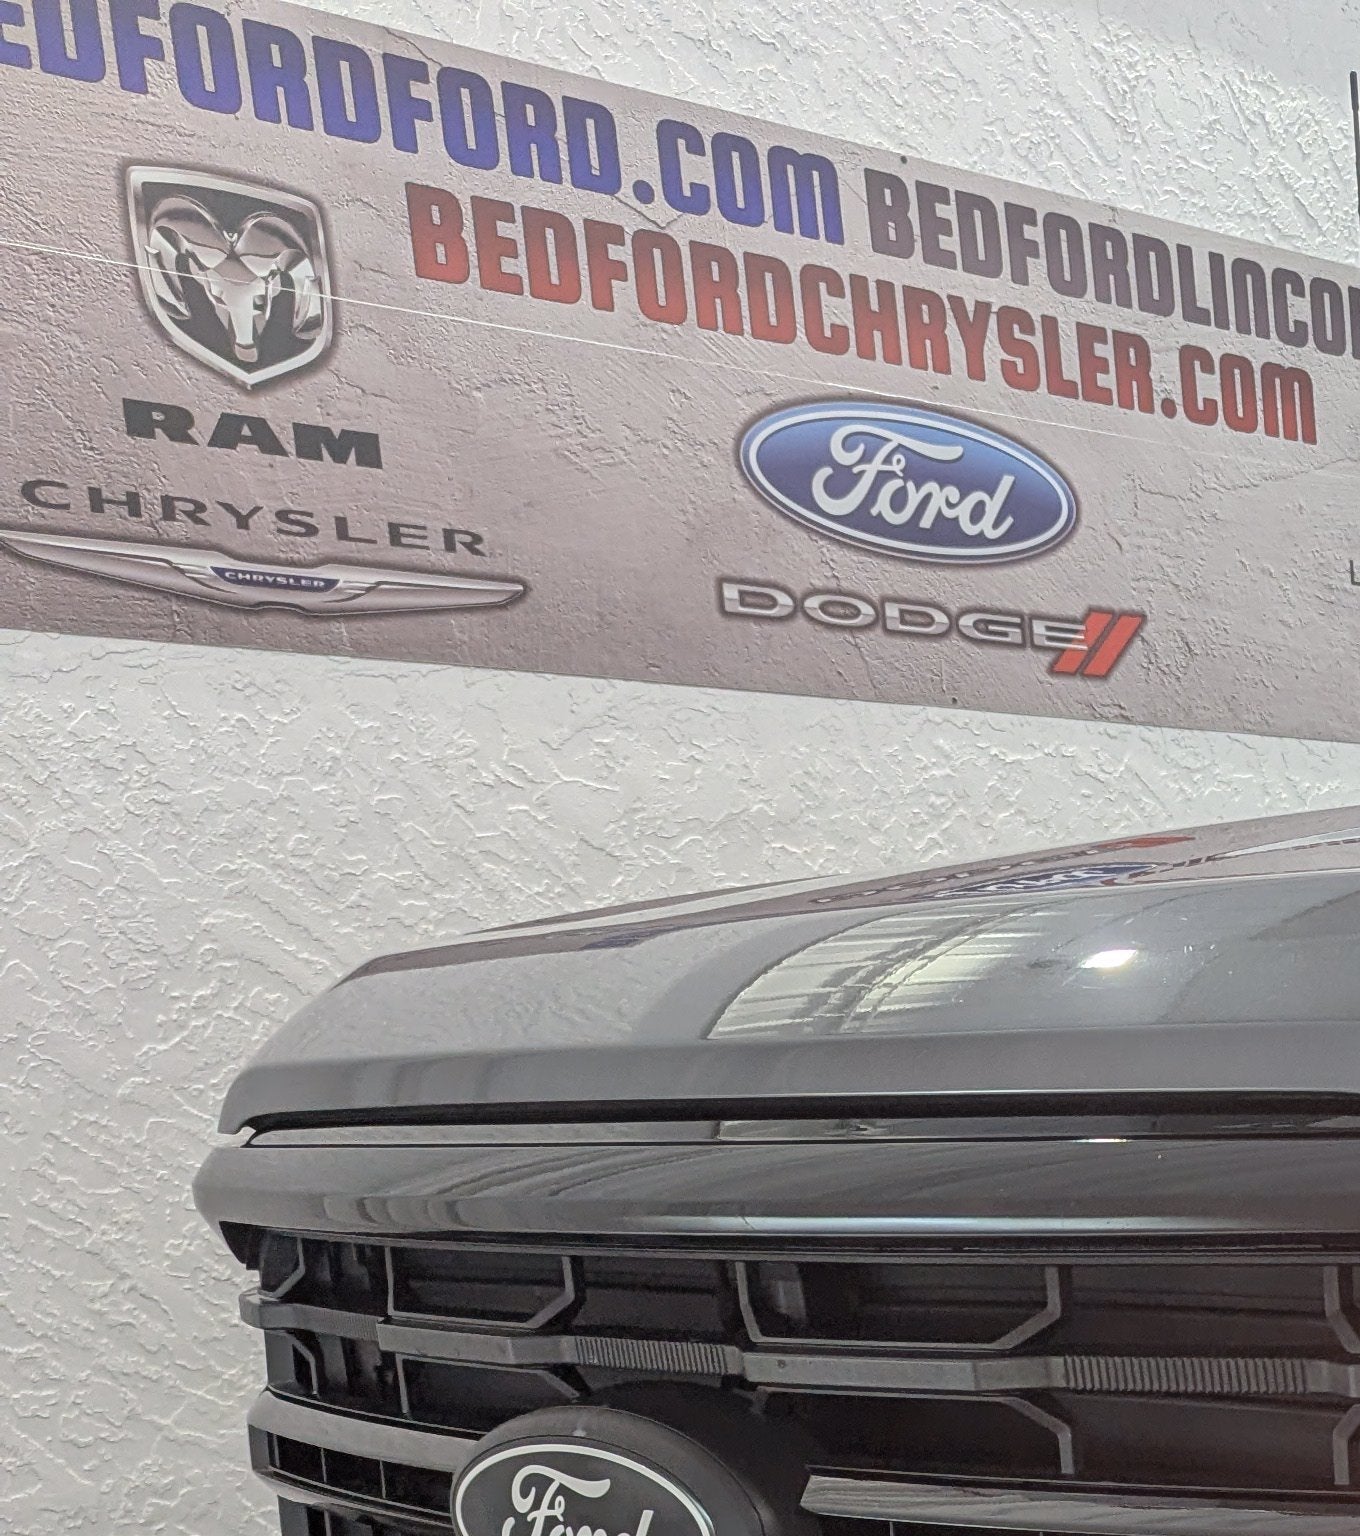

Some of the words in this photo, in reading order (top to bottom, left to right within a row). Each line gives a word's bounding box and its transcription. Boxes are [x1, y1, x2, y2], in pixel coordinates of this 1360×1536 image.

[405, 182, 1317, 445] BEDFORDCHRYSLER.COM
[123, 398, 383, 470] RAM
[21, 480, 486, 557] CHRYSLER
[812, 424, 1014, 539] Ford
[225, 571, 325, 587] CHRYSLER
[722, 582, 1088, 651] DODGE
